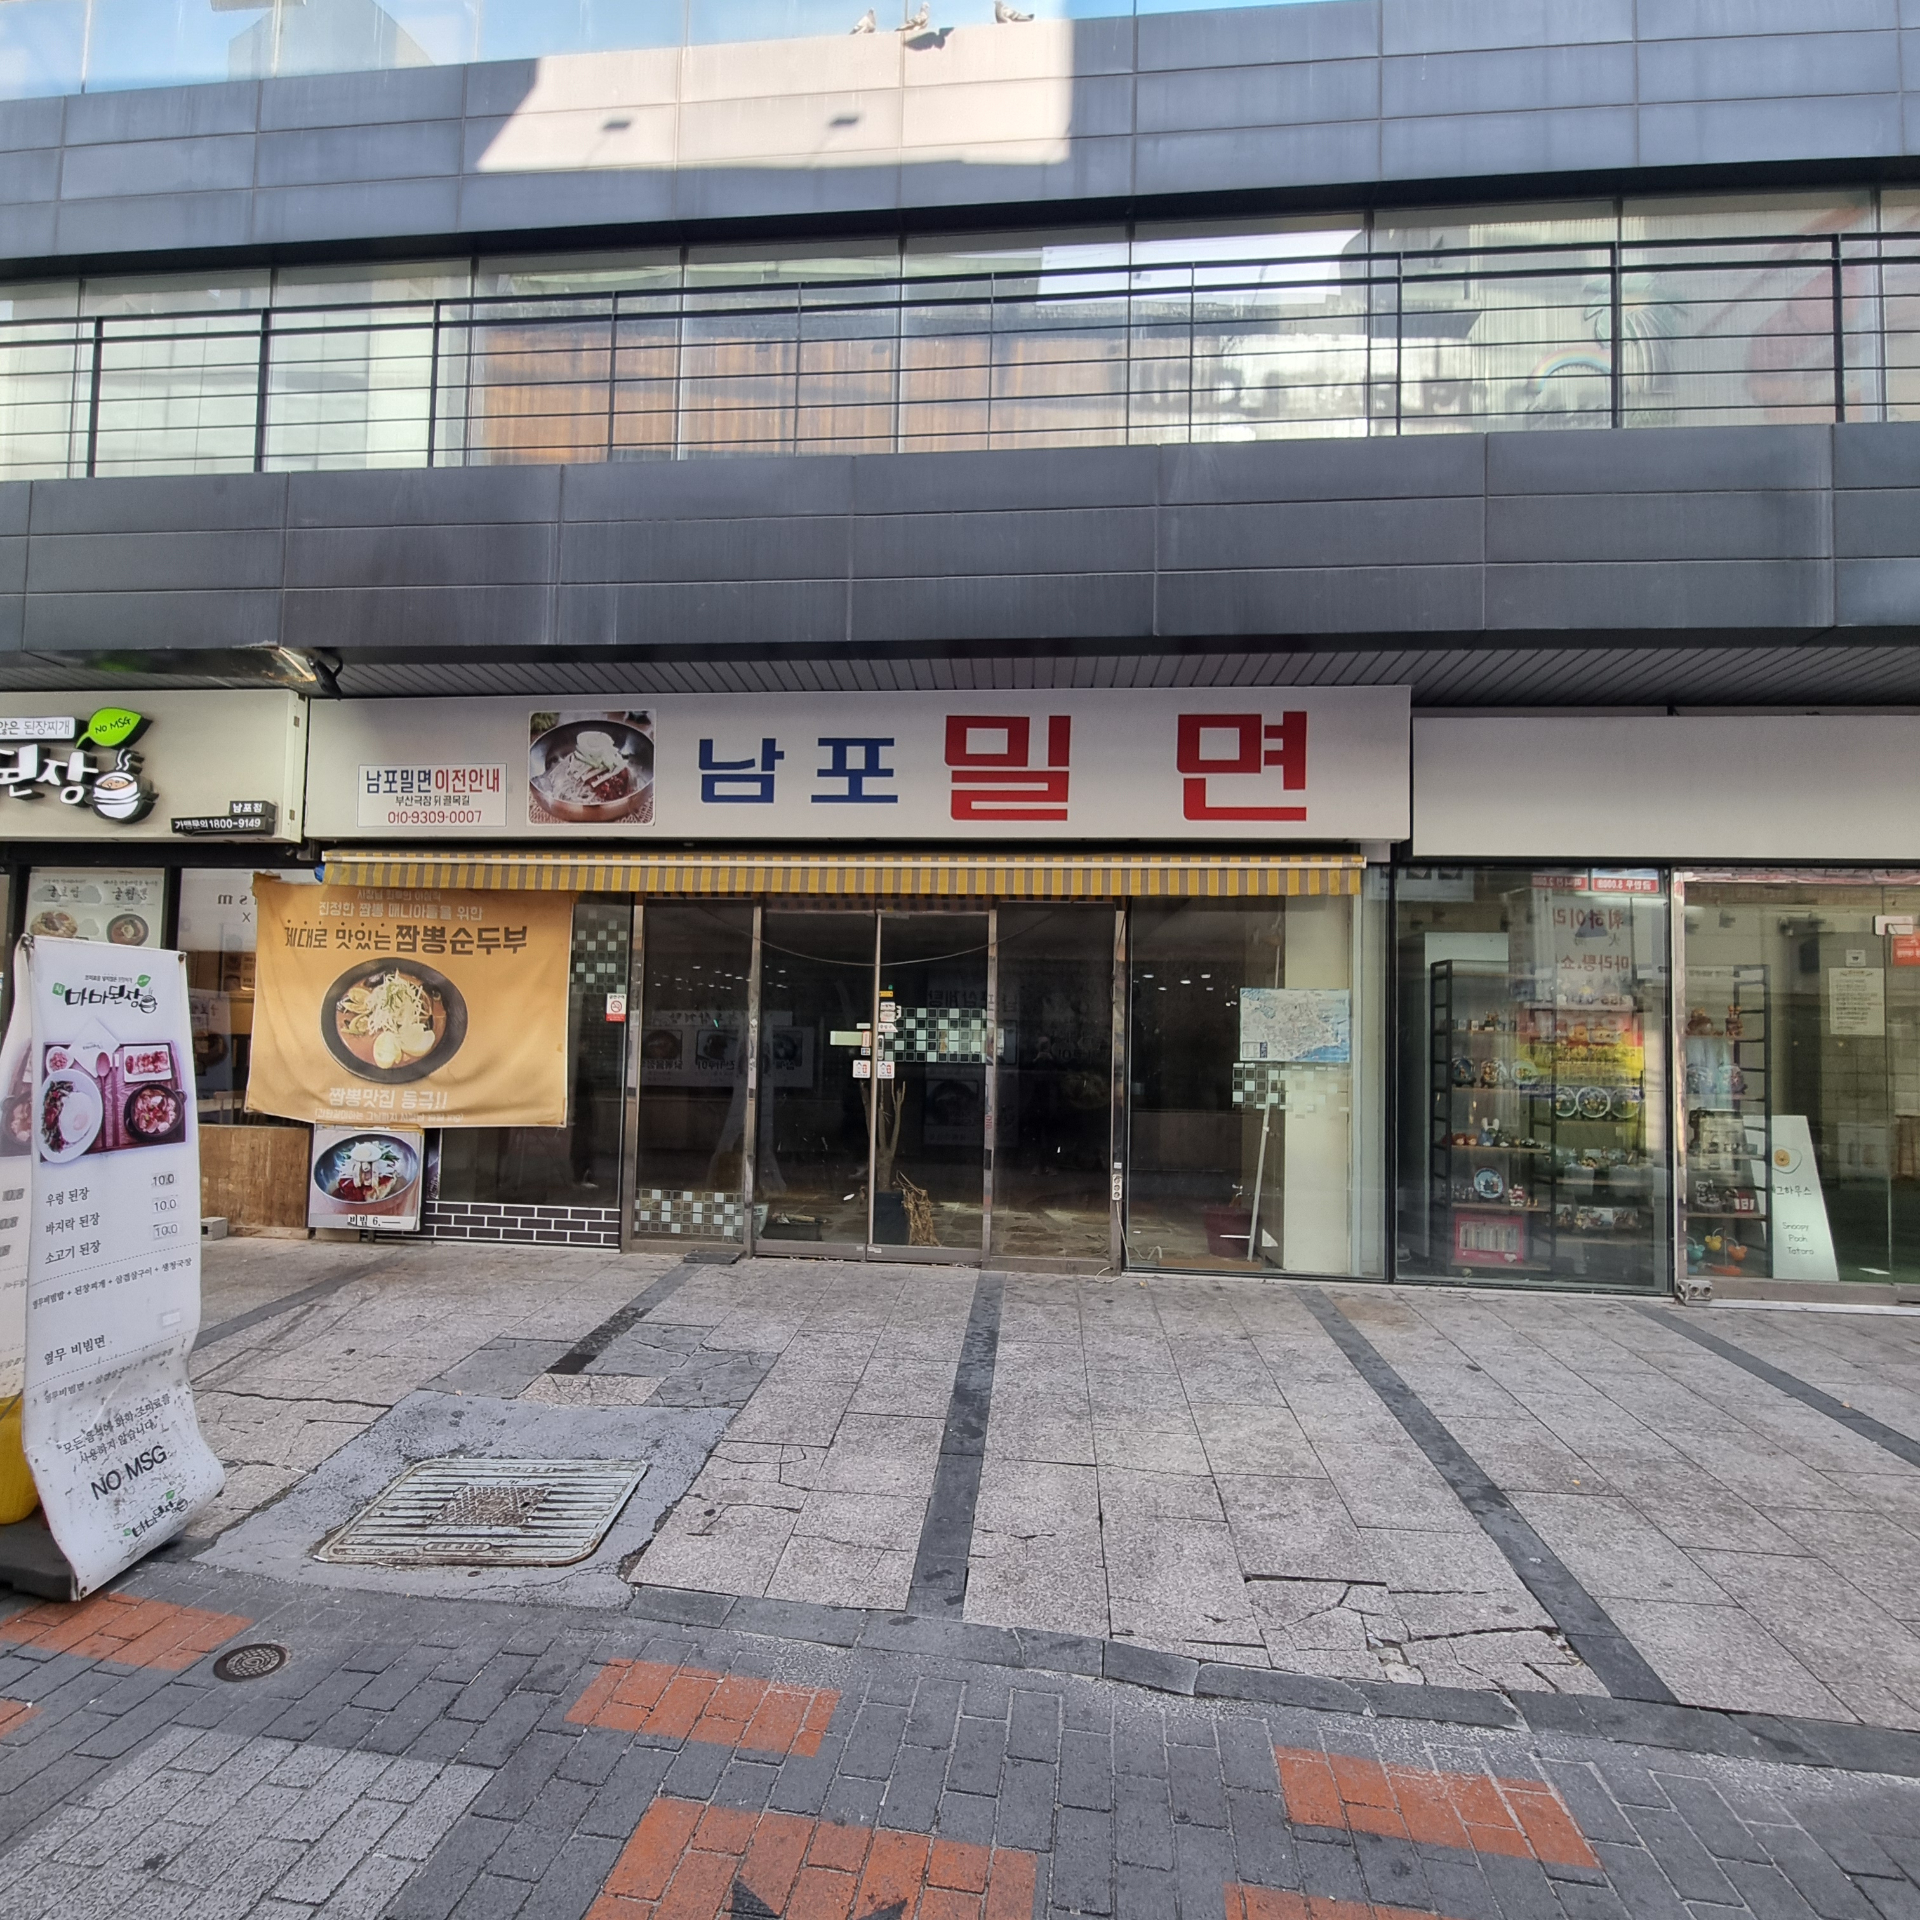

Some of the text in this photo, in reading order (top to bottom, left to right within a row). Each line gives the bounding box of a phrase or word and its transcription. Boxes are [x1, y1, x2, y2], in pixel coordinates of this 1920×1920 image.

[23, 720, 70, 736] 된장찌개
[94, 716, 132, 734] NO MSG
[232, 802, 263, 813] 남포점
[395, 795, 432, 807] 부산극장
[443, 795, 470, 806] 골목길
[387, 810, 482, 824] 010-9309-0007
[318, 901, 483, 922] 진정한 짬뽕 매니아들을 위한
[284, 926, 328, 949] 제대로
[64, 984, 144, 1008] 마마된장
[328, 1087, 448, 1110] 짬뽕맛집 등극!!
[45, 1186, 90, 1207] 우렁 된장
[154, 1199, 177, 1211] 10.0
[45, 1212, 100, 1235] 바지락 된장
[155, 1223, 178, 1237] 10.0
[1782, 1221, 1809, 1232] Snoopy
[45, 1239, 101, 1265] 소고기 된장
[44, 1347, 67, 1366] 열무
[70, 1335, 106, 1356] 비빔면
[79, 1438, 117, 1464] 사용하지
[91, 1444, 168, 1500] NO MSG
